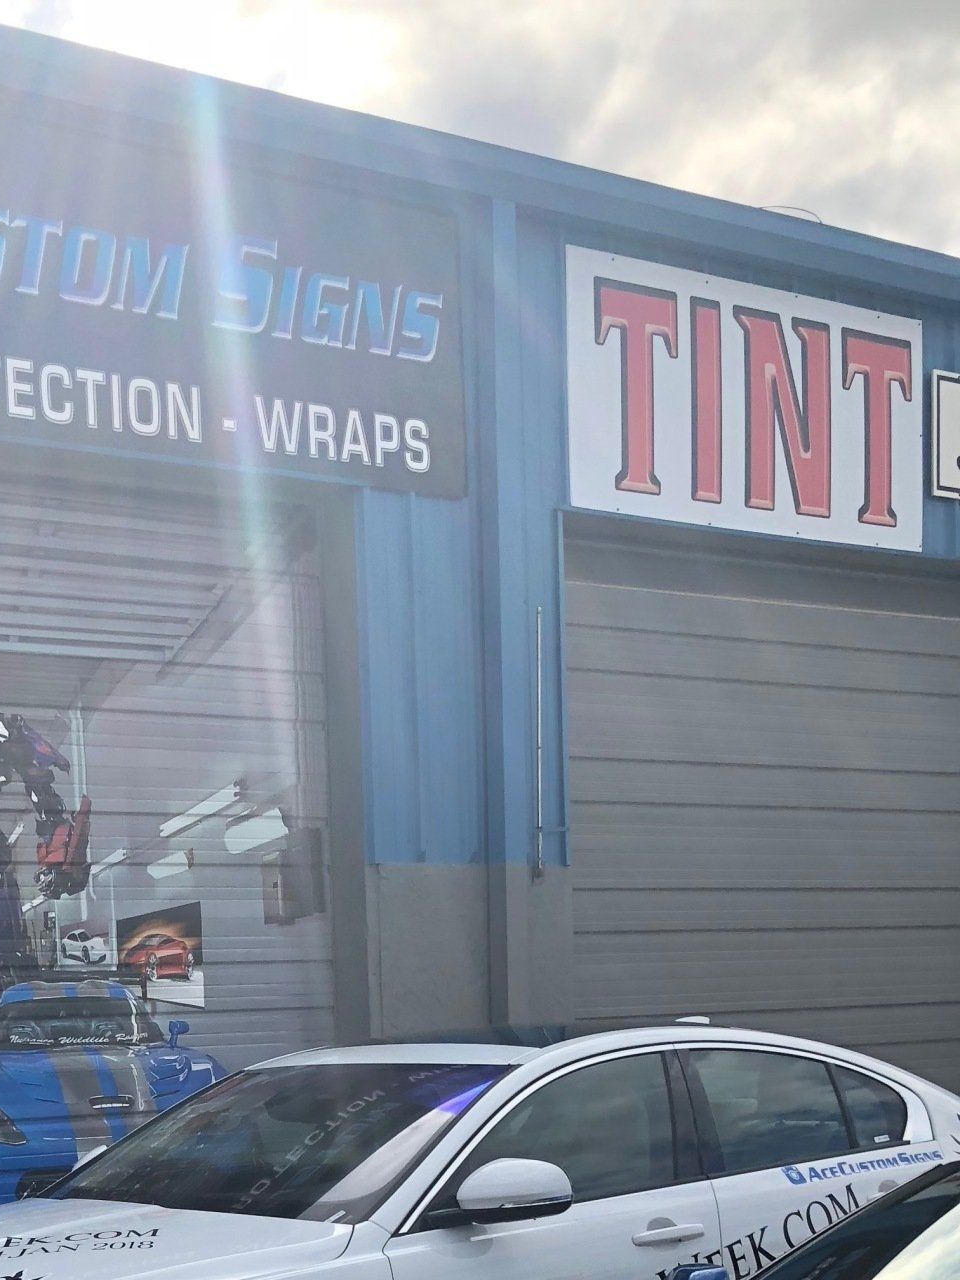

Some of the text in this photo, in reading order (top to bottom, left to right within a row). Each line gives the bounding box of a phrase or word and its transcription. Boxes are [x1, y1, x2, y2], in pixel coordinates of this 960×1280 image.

[211, 239, 443, 363] SIGNS
[254, 394, 432, 474] WRAPS
[593, 276, 912, 528] TINT
[7, 1244, 82, 1259] JAN
[93, 1240, 155, 1251] 2018
